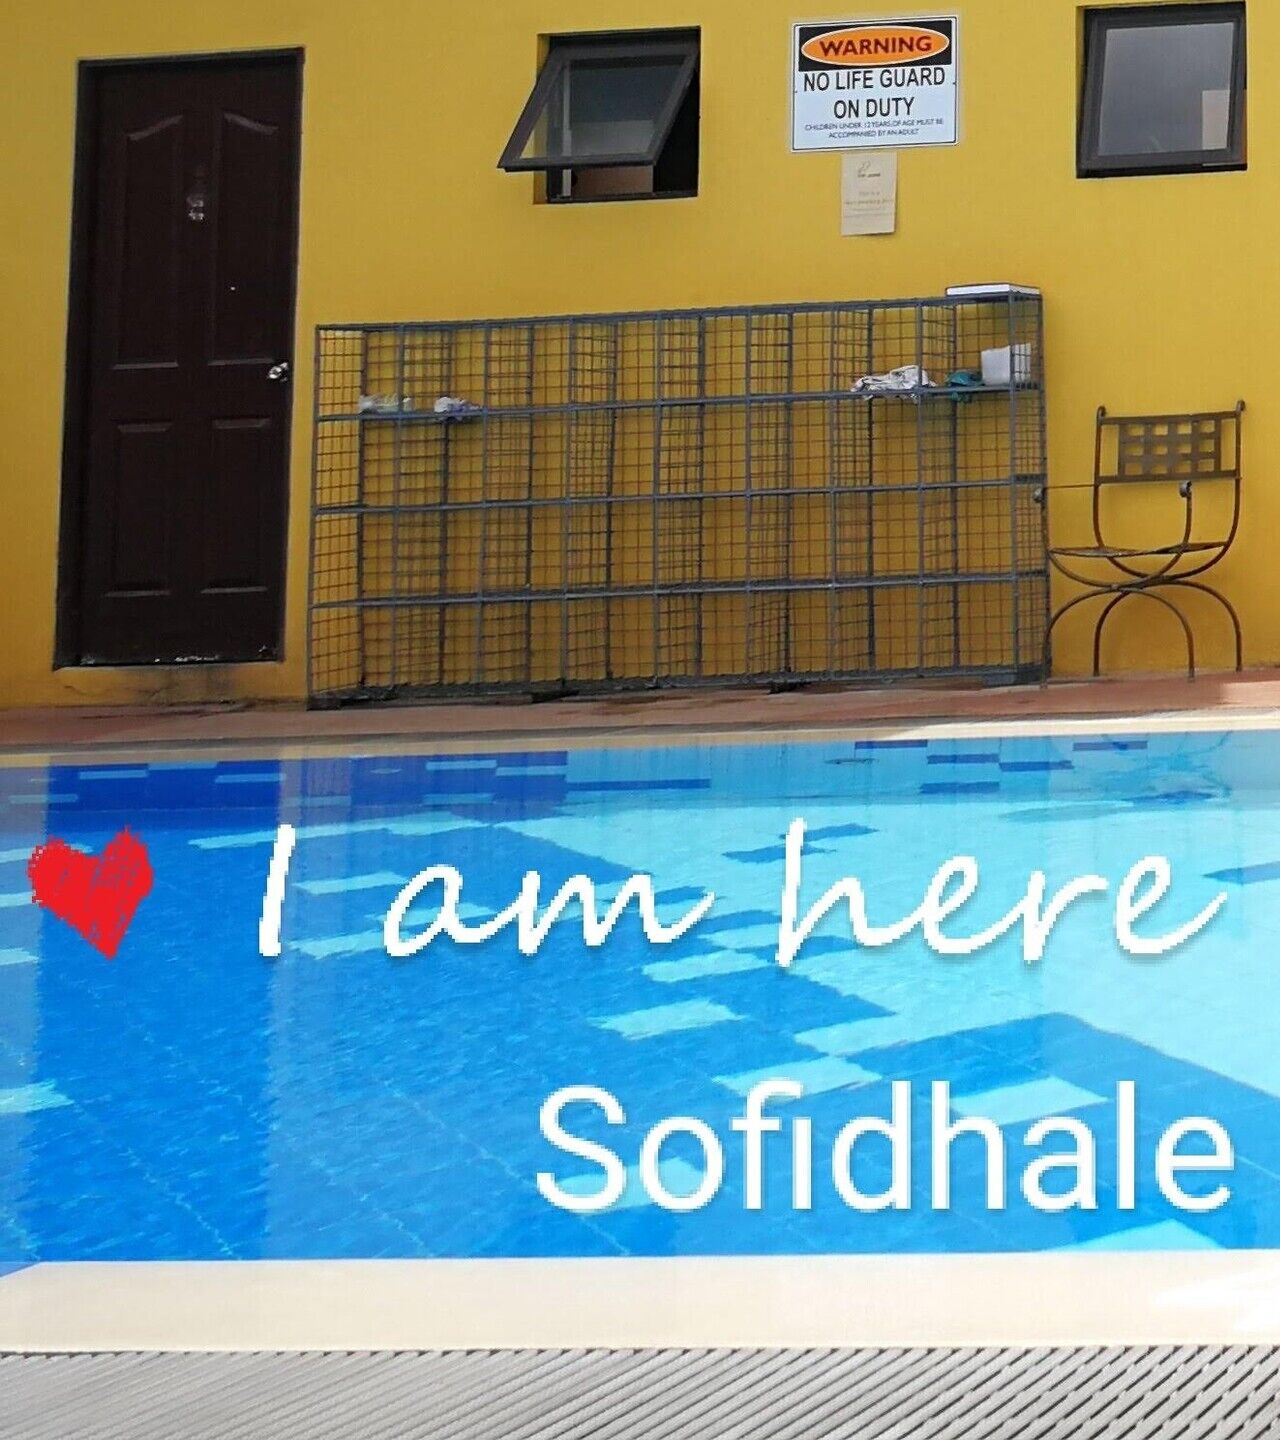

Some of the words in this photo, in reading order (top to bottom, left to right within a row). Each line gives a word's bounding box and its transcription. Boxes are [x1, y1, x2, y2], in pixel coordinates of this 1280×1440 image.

[819, 35, 932, 57] WARNING
[803, 72, 830, 92] NO
[835, 70, 874, 90] LIFE
[880, 67, 945, 88] GUARD
[833, 99, 860, 119] ON
[866, 96, 915, 117] DUTY
[805, 123, 838, 131] CHILDREN
[916, 118, 934, 126] MUST
[935, 117, 943, 125] BE
[829, 130, 876, 138] ACCOMPANIED
[898, 128, 919, 136] ADULT
